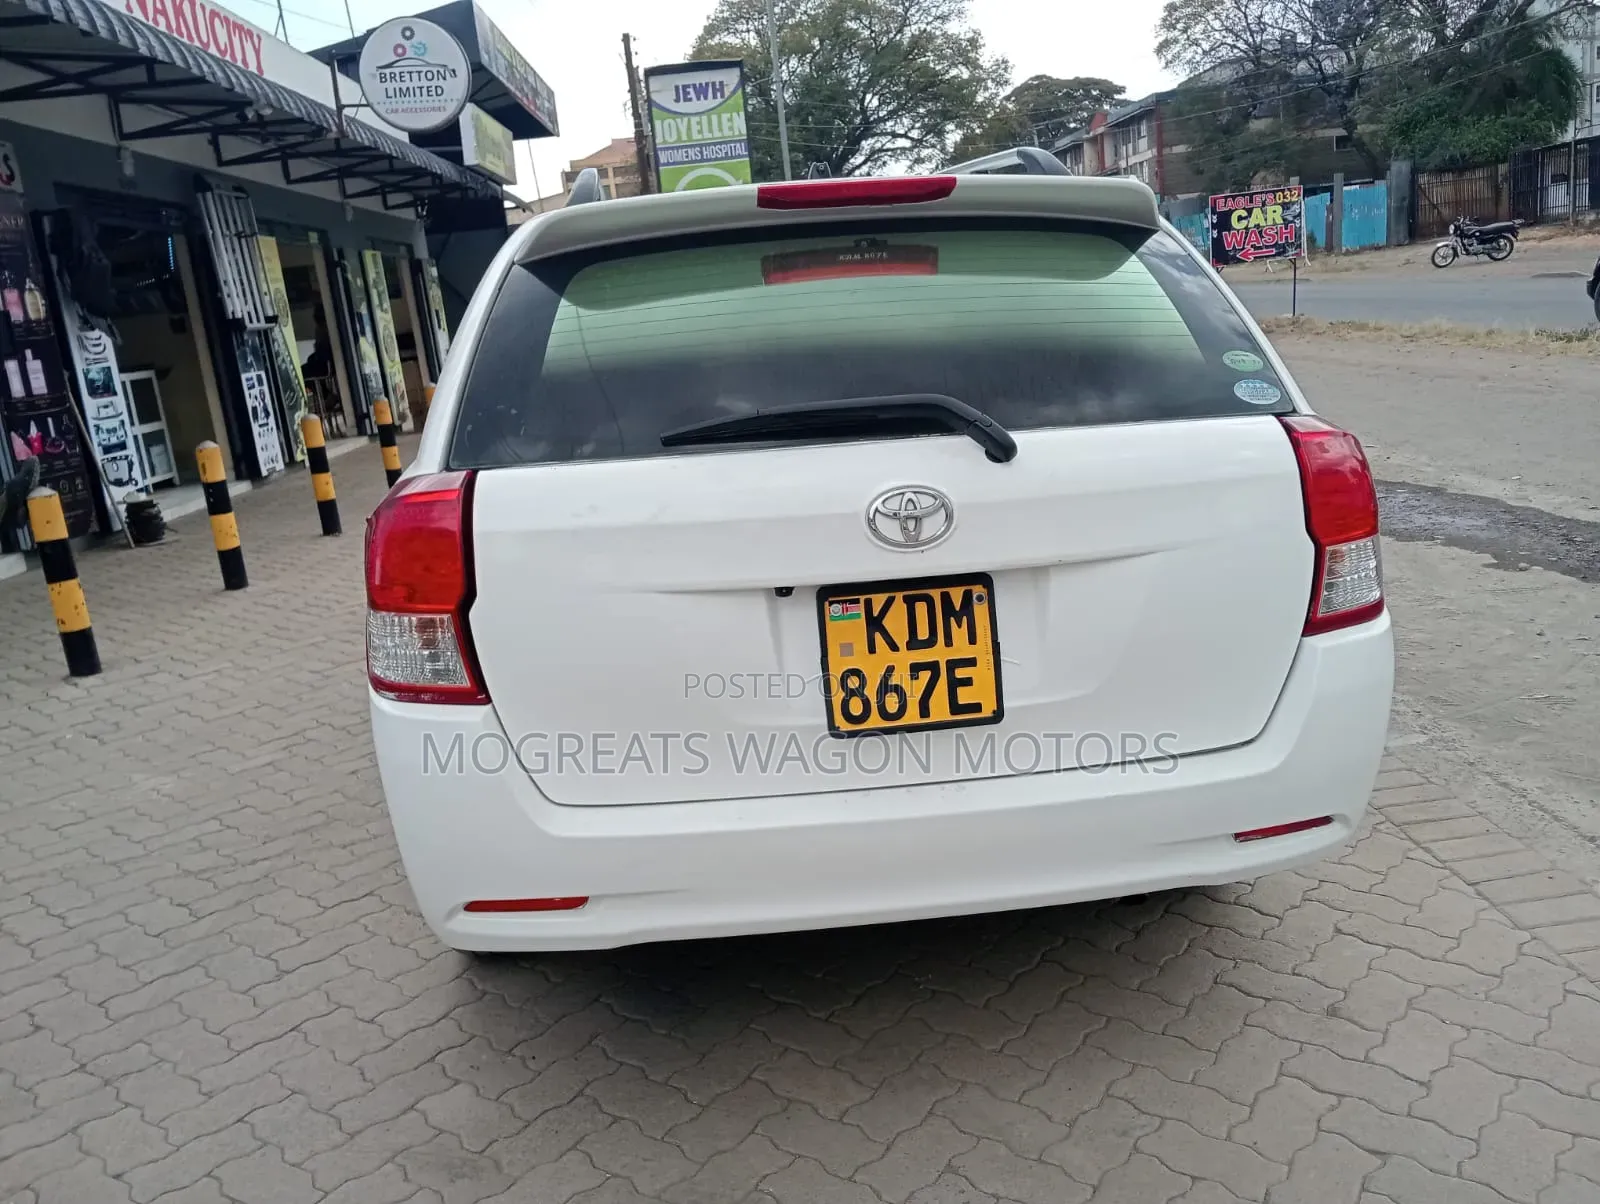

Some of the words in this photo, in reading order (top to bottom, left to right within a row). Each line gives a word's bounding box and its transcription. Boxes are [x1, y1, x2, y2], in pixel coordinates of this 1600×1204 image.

[379, 69, 447, 83] BRETTON
[385, 85, 444, 99] LIMITED
[673, 80, 725, 103] JEWH
[654, 111, 747, 143] JOYELLEN
[658, 147, 702, 164] WOMENS
[703, 142, 748, 159] HOSPITAL
[1216, 193, 1275, 211] EAGLE'S
[1276, 190, 1299, 203] 032
[1231, 205, 1284, 229] CAR
[1222, 223, 1295, 250] WASH
[863, 589, 977, 654] KDM
[840, 656, 983, 725] 867E
